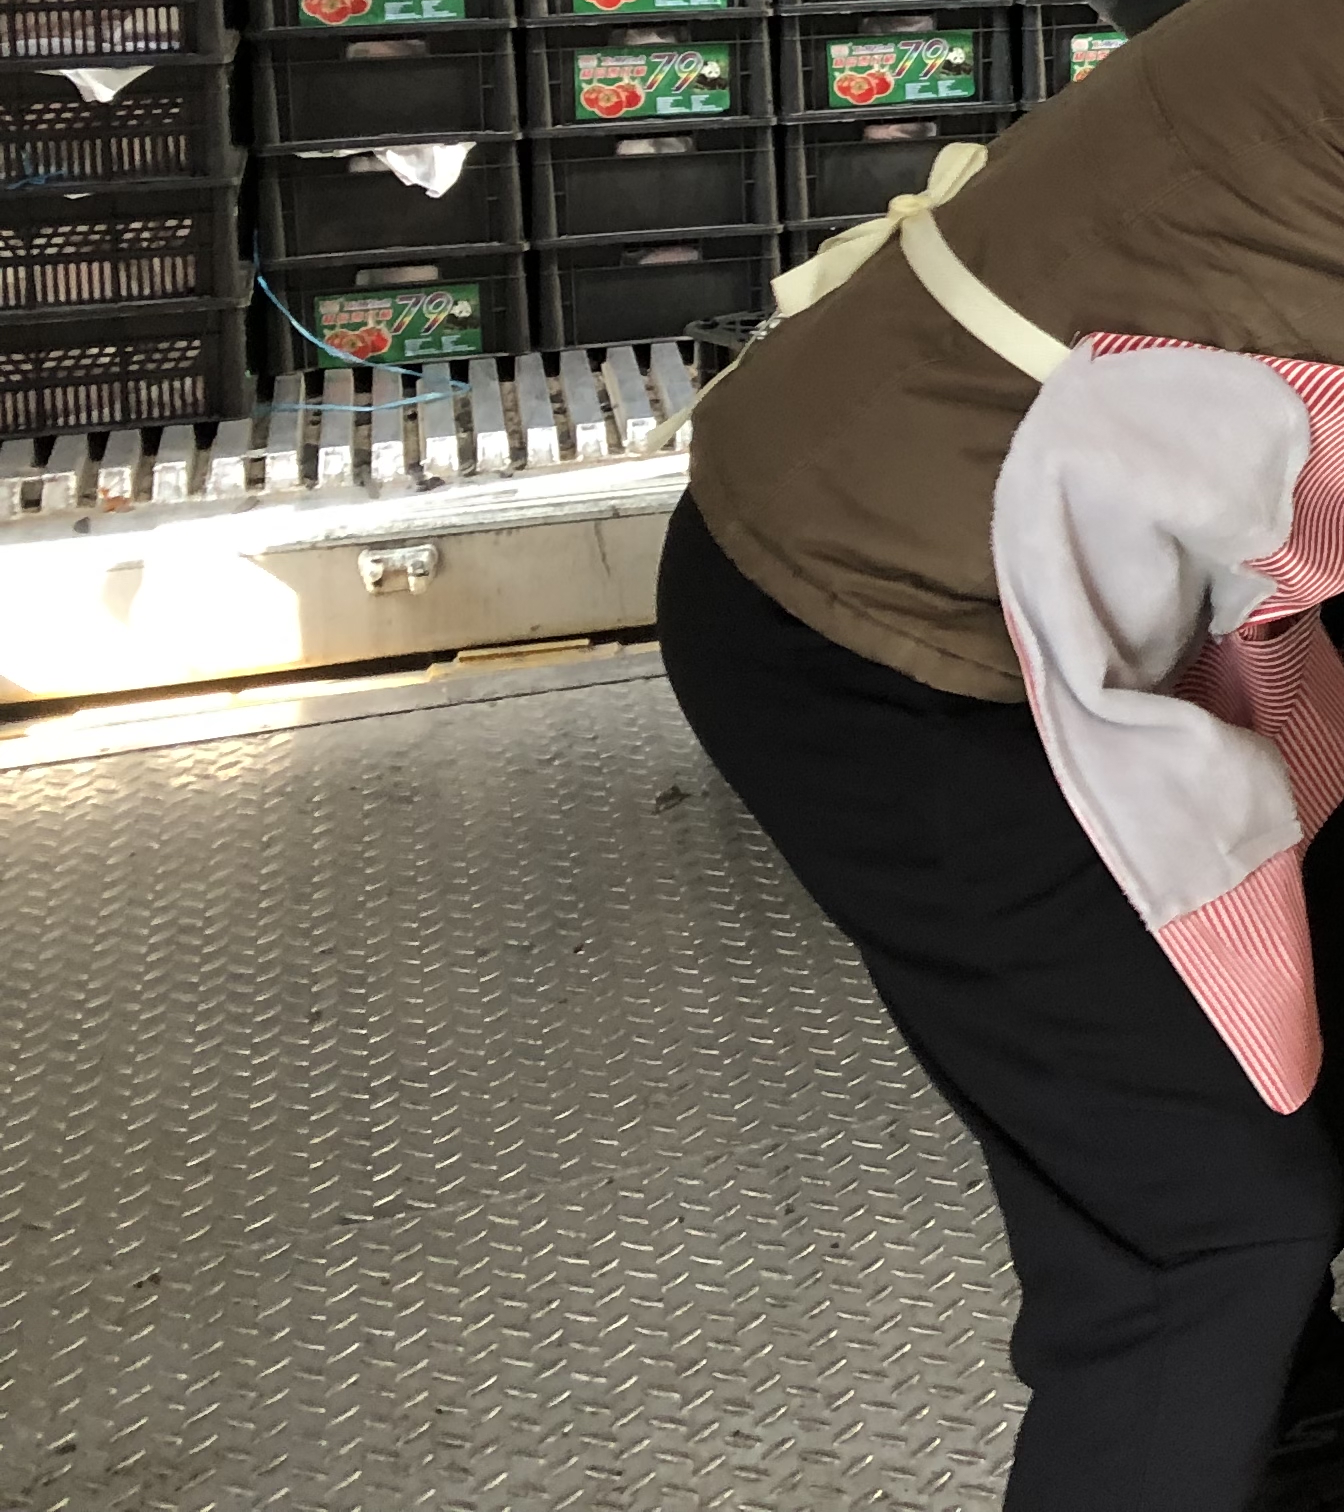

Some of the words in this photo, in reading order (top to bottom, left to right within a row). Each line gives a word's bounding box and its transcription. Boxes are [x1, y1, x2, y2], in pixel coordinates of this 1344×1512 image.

[645, 51, 704, 93] 79
[893, 37, 949, 77] 79
[392, 291, 453, 335] 79
